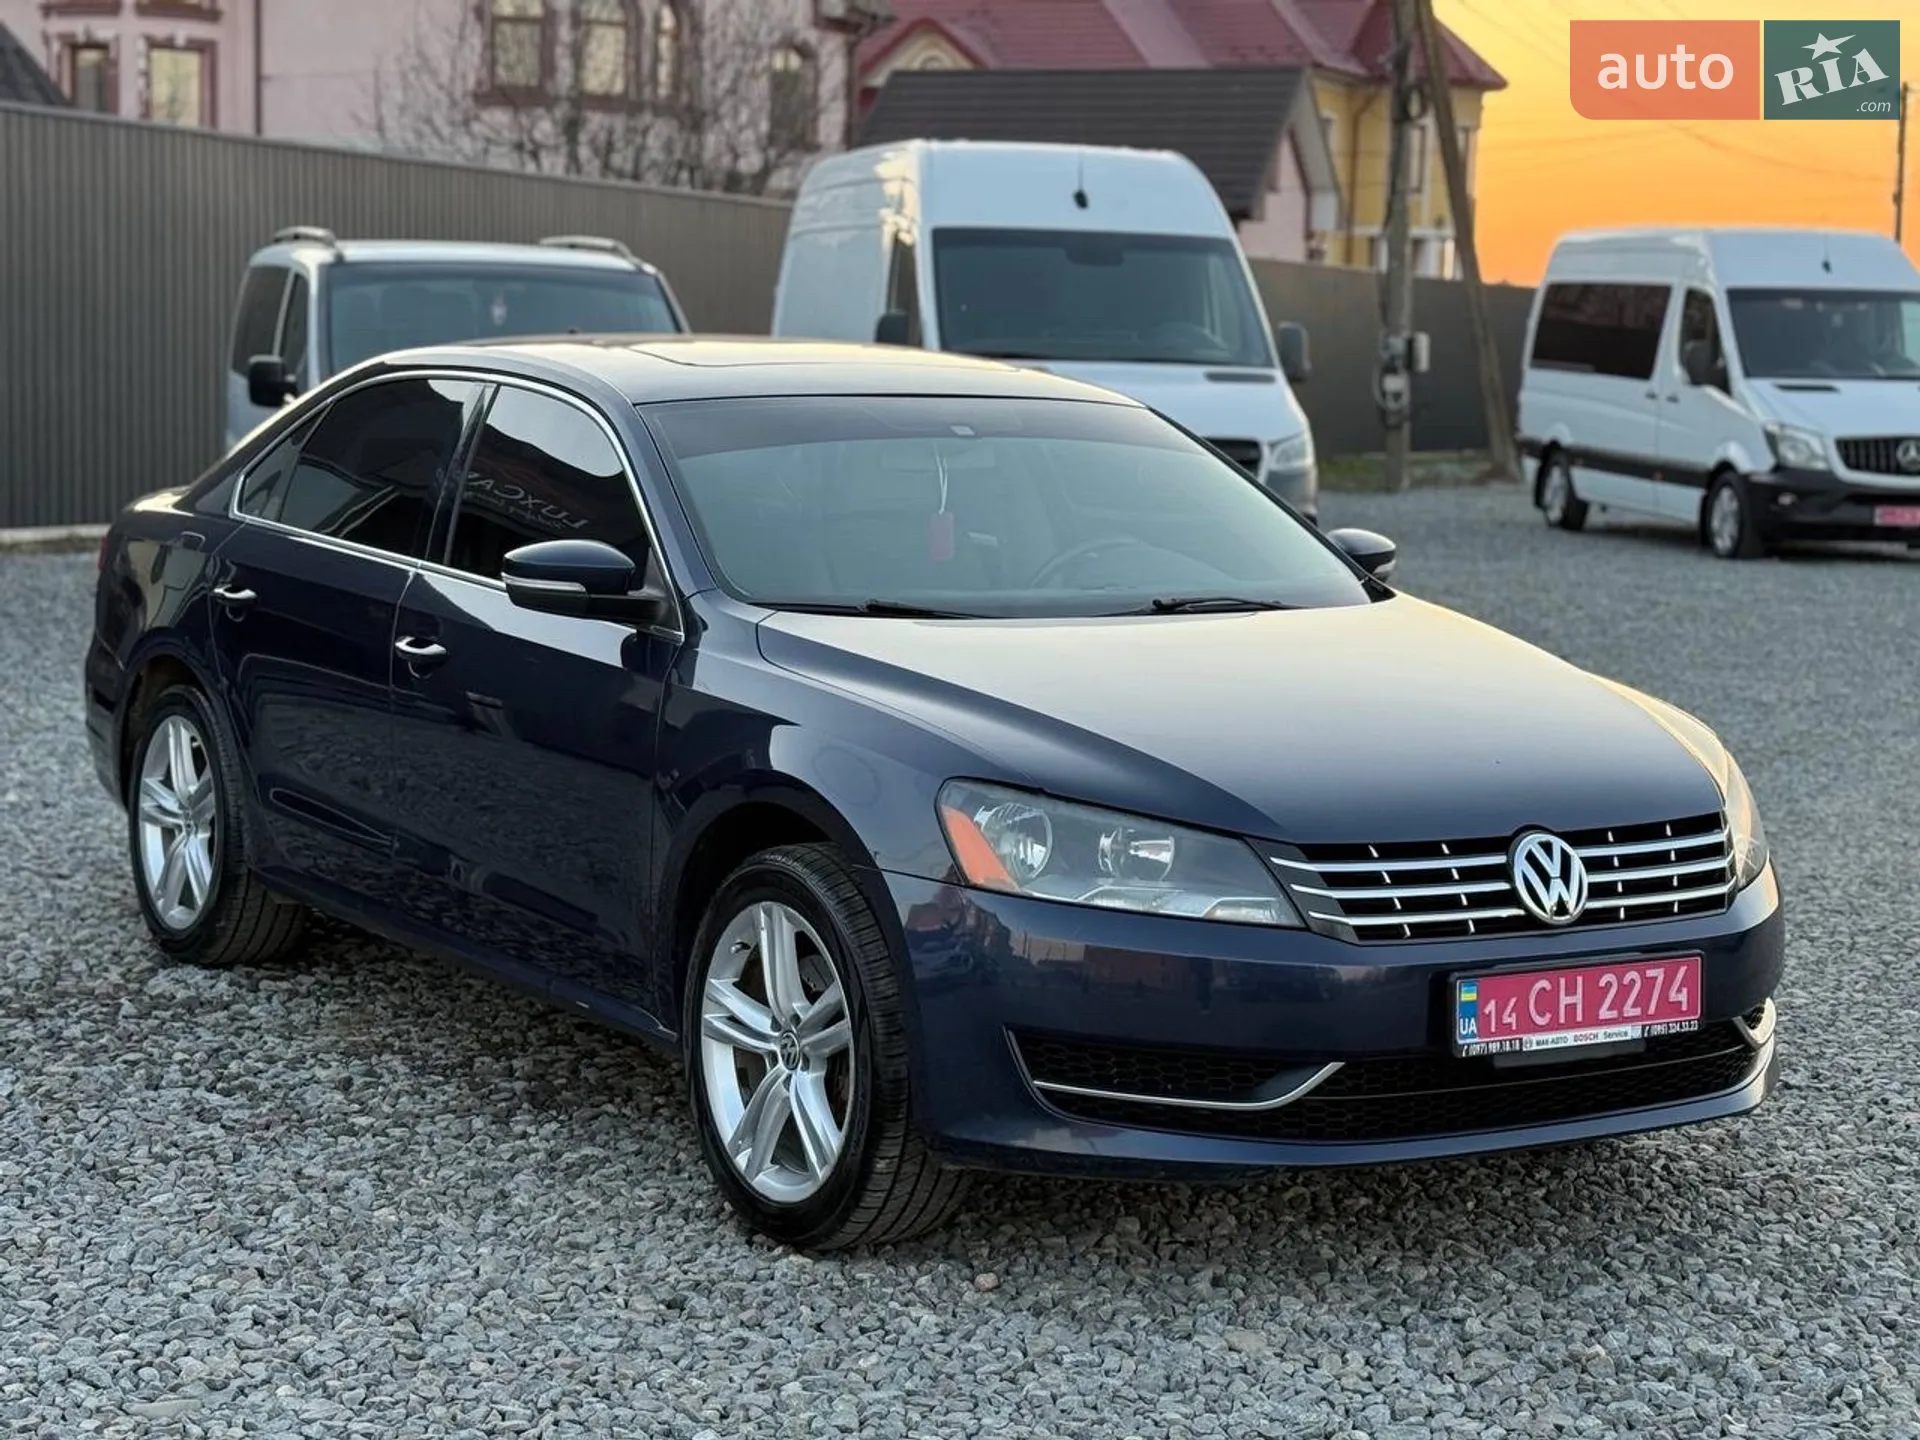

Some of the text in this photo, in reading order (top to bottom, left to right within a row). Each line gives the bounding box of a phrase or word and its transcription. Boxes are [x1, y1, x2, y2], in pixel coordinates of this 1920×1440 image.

[1514, 833, 1588, 922] VW
[1482, 964, 1688, 1034] 14 CH 2274
[1460, 1017, 1478, 1035] UA
[1573, 1029, 1629, 1042] BOSCH Service
